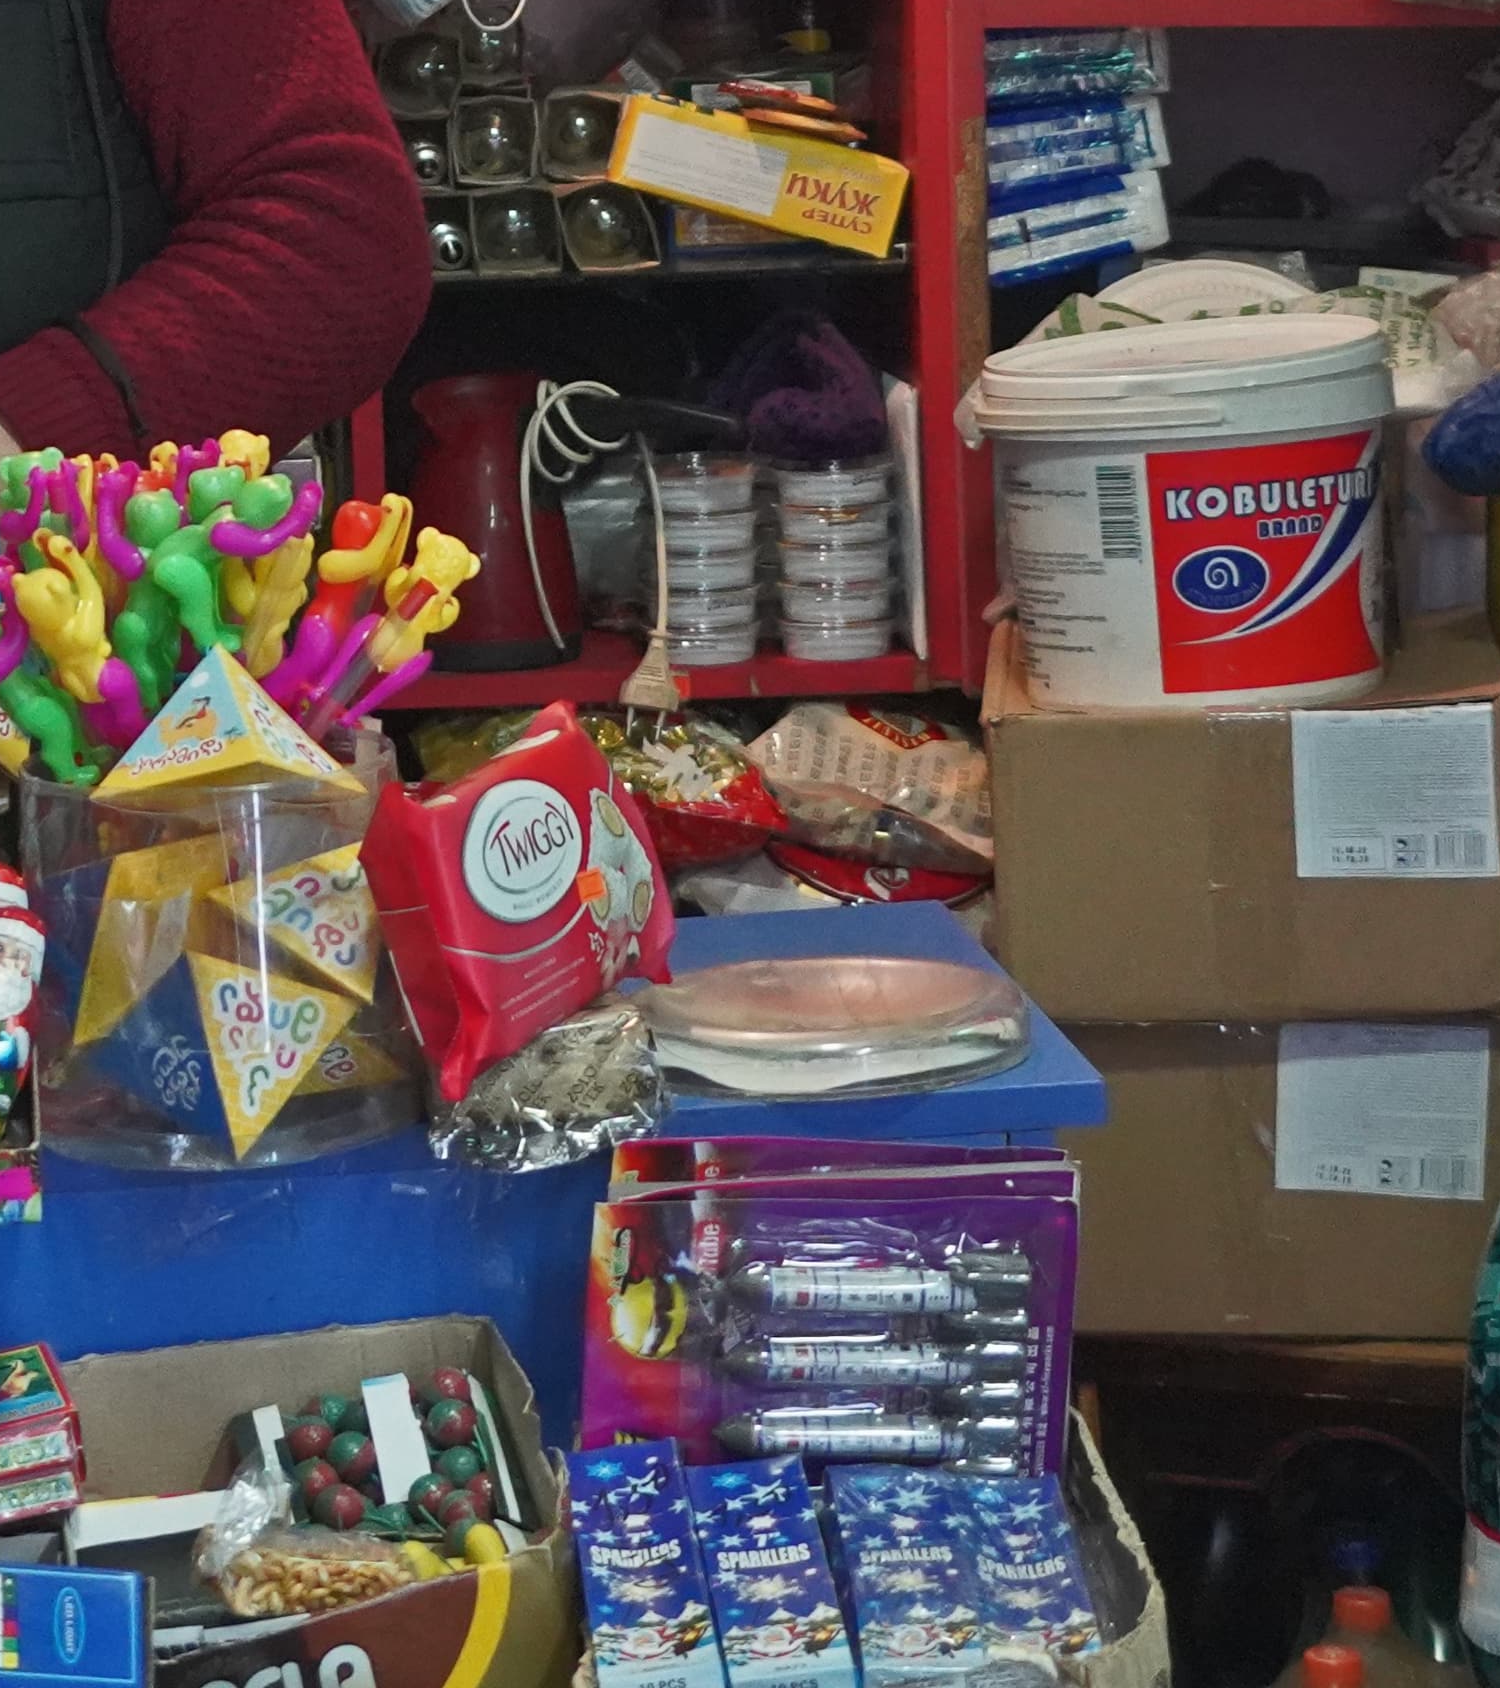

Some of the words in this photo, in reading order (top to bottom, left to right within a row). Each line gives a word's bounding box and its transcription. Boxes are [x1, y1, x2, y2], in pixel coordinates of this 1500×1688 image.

[782, 171, 881, 217] ЖУКИ
[800, 205, 874, 235] СУПЕР
[1257, 515, 1324, 541] BRAND
[491, 800, 577, 880] TWIGGY
[590, 1540, 684, 1571] SPARKLERS
[717, 1540, 812, 1573] SPARKLERS
[859, 1546, 954, 1565] SPARKLERS
